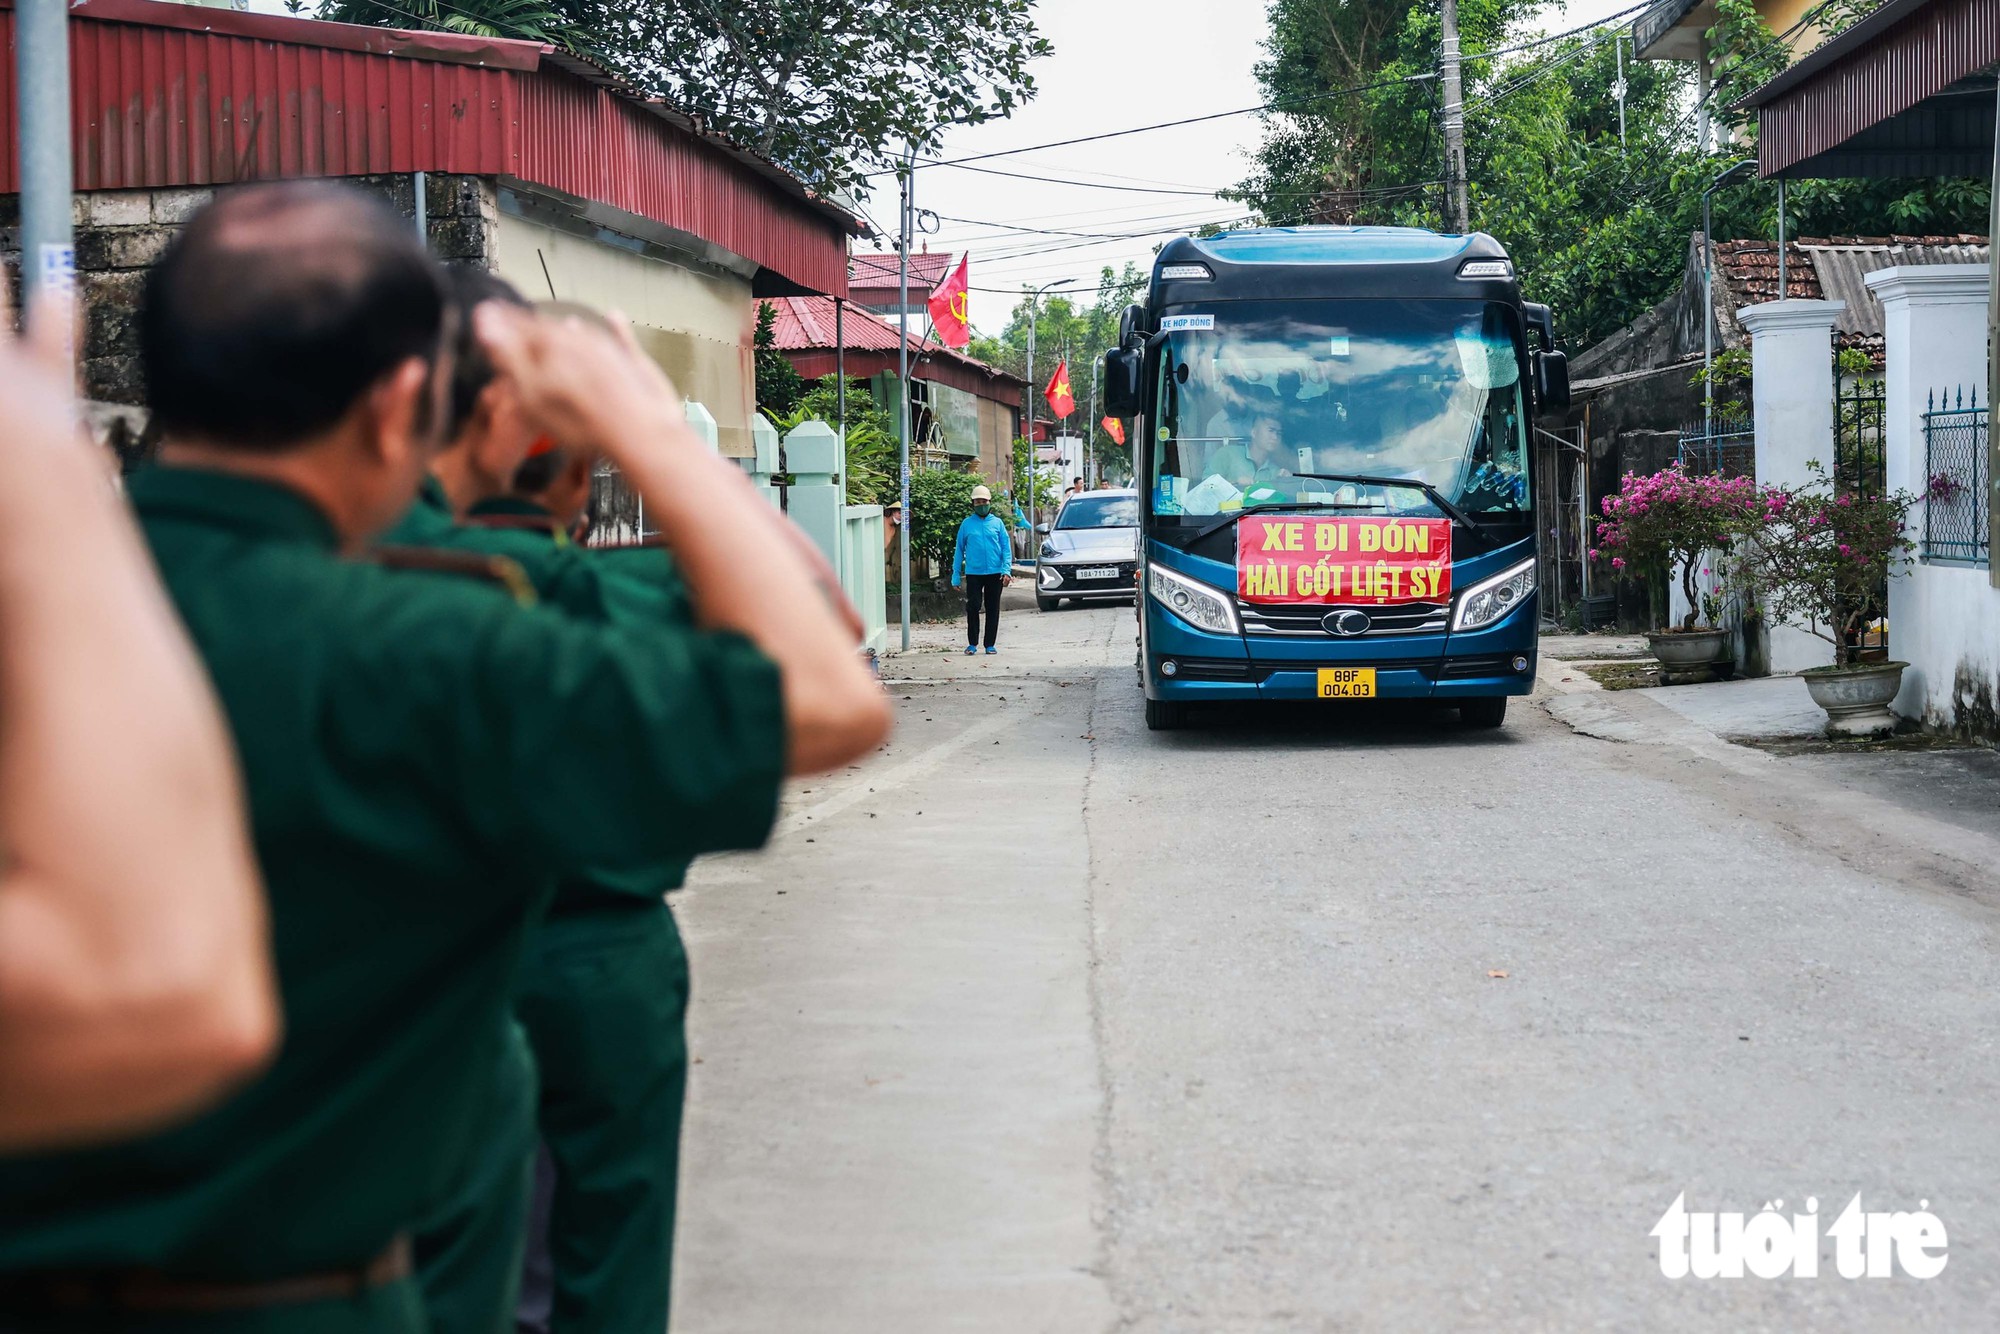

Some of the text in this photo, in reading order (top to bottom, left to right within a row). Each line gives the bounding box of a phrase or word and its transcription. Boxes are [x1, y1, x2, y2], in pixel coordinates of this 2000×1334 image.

[1163, 320, 1171, 328] XE
[1262, 519, 1429, 553] XE ĐI ĐÓN
[1246, 554, 1443, 604] HÀI CỐT LIỆT SỸ
[1334, 670, 1359, 682] 88F
[1324, 684, 1369, 696] 004.03
